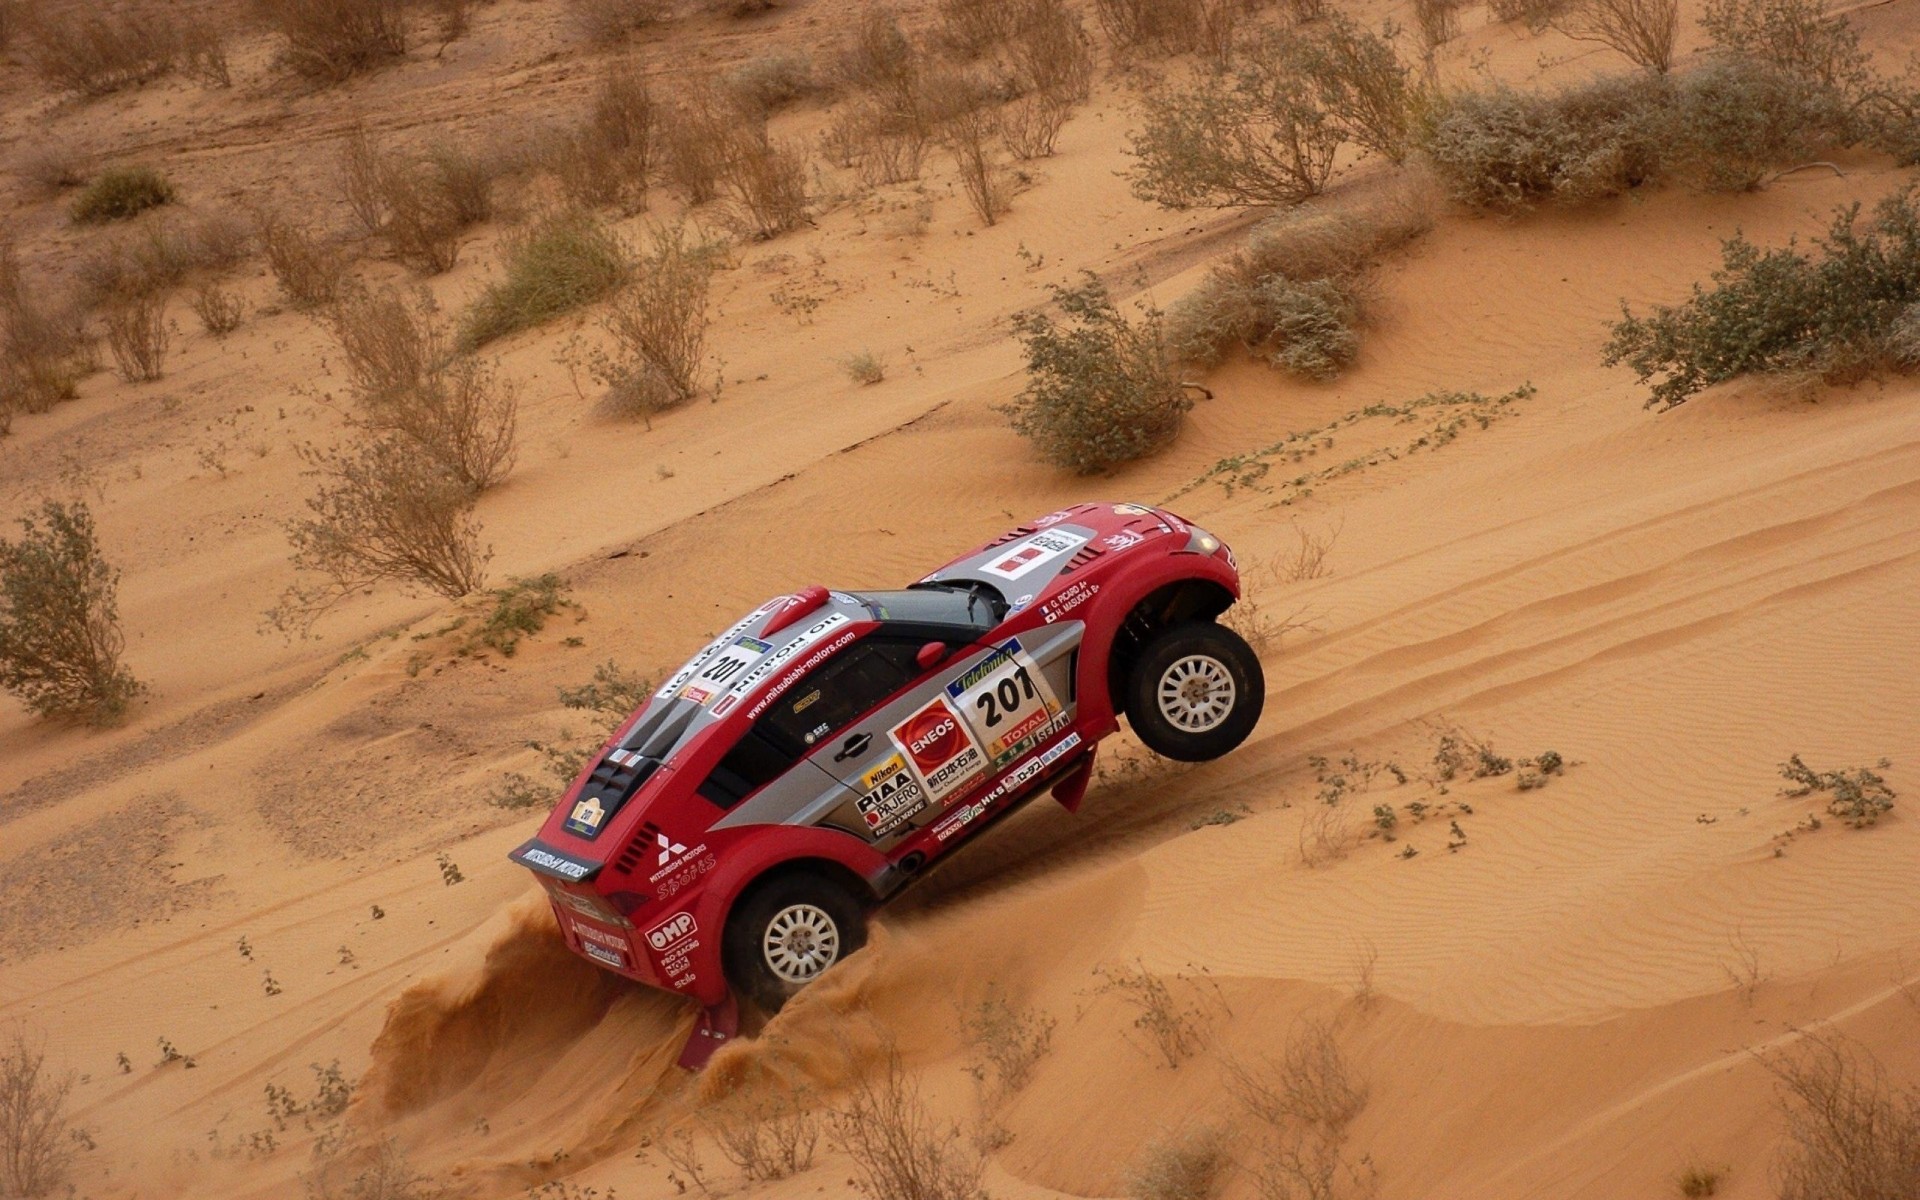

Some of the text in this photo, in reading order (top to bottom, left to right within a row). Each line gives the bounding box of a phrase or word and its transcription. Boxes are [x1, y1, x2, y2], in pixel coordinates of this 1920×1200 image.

[1058, 585, 1079, 604] PICARD
[1063, 589, 1092, 612] MASUOKA
[702, 656, 747, 683] 201
[735, 637, 805, 693] NIPPON
[809, 615, 843, 634] OIL
[746, 631, 856, 720] www.mitsubishi-motors.com
[977, 666, 1034, 727] 201
[910, 718, 955, 755] ENEOS
[1003, 712, 1047, 744] TOTAL
[870, 762, 898, 785] Nikon
[927, 747, 978, 789] 新日本石油
[1017, 760, 1043, 781] ロータス
[857, 772, 911, 813] PIAA
[877, 784, 919, 818] PAJERO
[981, 785, 1005, 806] HKS
[649, 843, 707, 884] MITSUBISHI MOTORS
[651, 914, 691, 948] OMP
[666, 956, 689, 975] NGK
